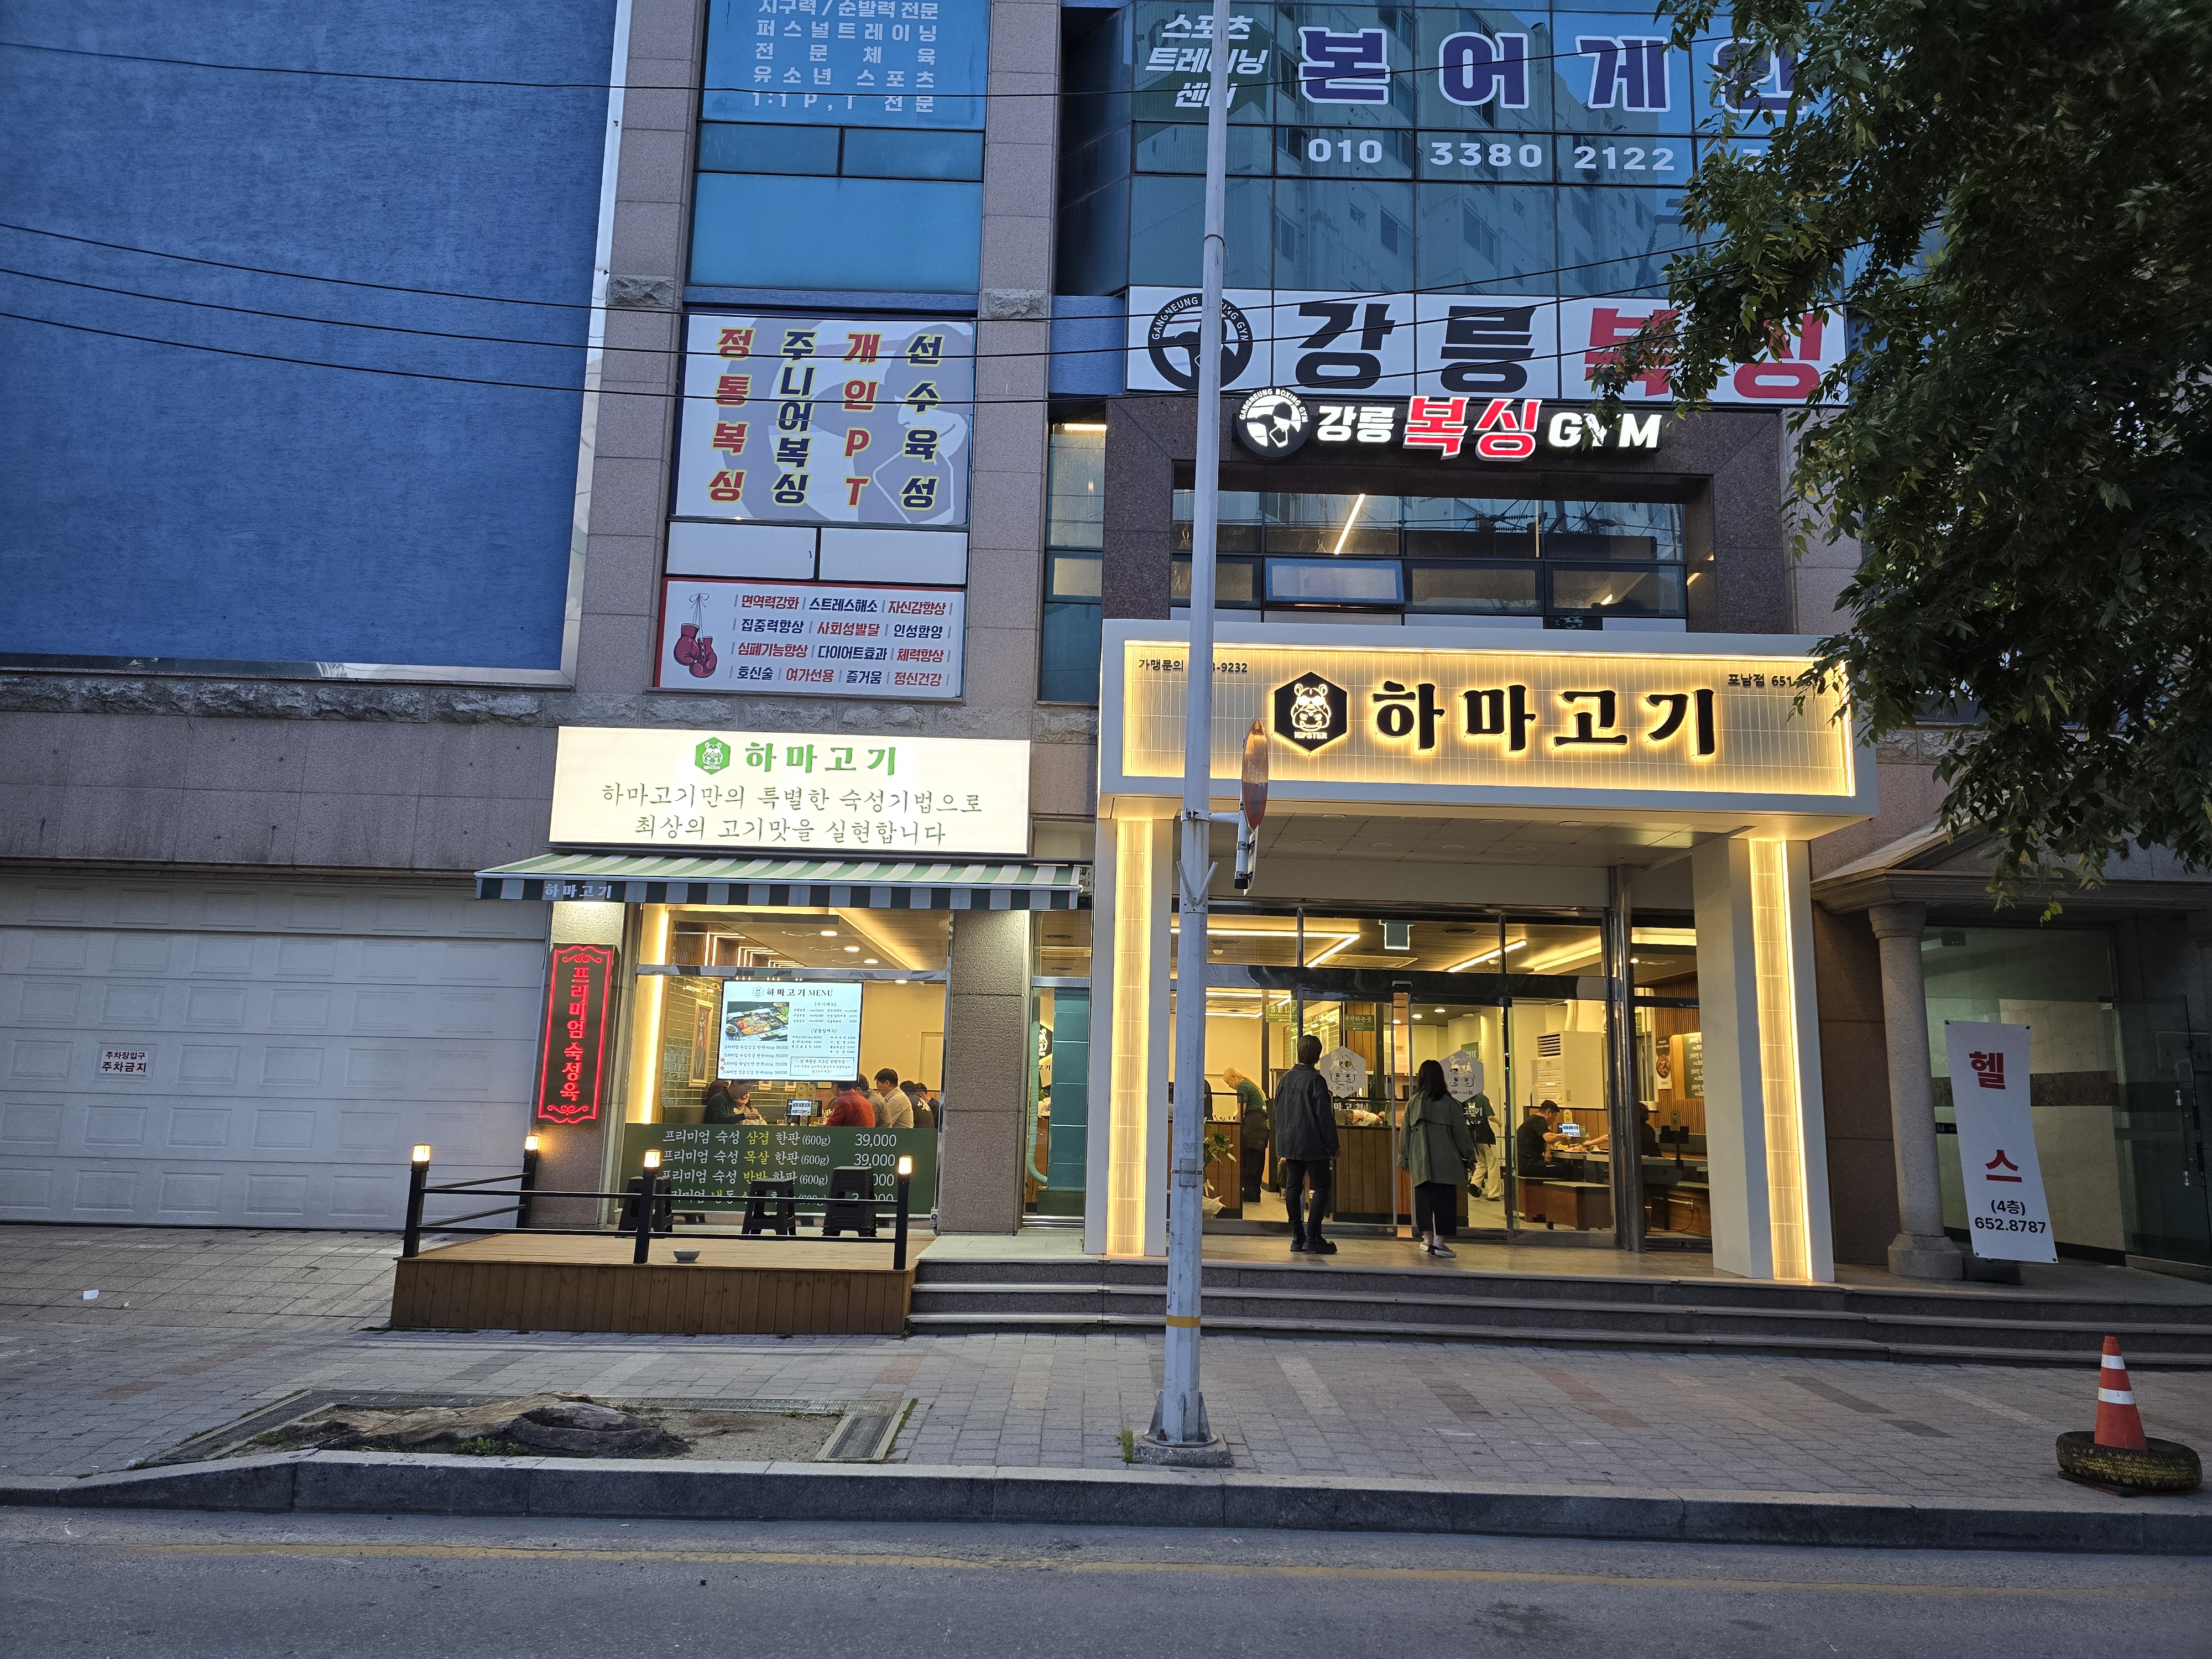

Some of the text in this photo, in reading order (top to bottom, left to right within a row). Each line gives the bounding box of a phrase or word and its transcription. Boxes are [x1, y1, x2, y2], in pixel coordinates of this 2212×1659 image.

[901, 2, 938, 20] 전문
[1161, 14, 1253, 40] 스포츠
[753, 66, 935, 89] 유소년 스포츠
[884, 95, 935, 113] 전문
[1308, 139, 1675, 171] 010 3380 2122
[1151, 296, 1199, 340] GANGNEUNG
[1237, 321, 1250, 342] GYM
[708, 327, 755, 503] 정통복싱
[1239, 388, 1310, 423] GANGNEUNG BOXING GYM
[899, 333, 945, 511] 선수육성
[1548, 411, 1663, 449] GYM
[740, 594, 947, 615] 면역력강화 스트레스해소 자신감향상
[741, 618, 943, 639] 집중력향상 사회성발달 인성함양
[737, 642, 945, 664] 심폐기능향상 다이어트효과 체력향상
[737, 665, 943, 687] 호신술 여가선용 즐거움 정신건강
[1138, 659, 1184, 672] 가맹문의
[1728, 673, 1765, 687] 포남점
[1371, 680, 1715, 756] 하마고기
[1293, 731, 1328, 740] HIPSTER
[745, 742, 897, 776] 하마고기
[601, 782, 983, 816] 하마고기만의 특별한 숙성기법으로
[634, 815, 946, 847] 최상의 고기맛을 실현합니다
[545, 884, 612, 899] 하마고기
[766, 988, 806, 997] 하마고기
[106, 1051, 145, 1060] 주차장입구
[102, 1062, 147, 1073] 주차금지
[1333, 1102, 1364, 1112] 마고기
[1969, 1051, 2023, 1183] 헬스
[662, 1129, 710, 1144] 프리미엄
[714, 1130, 740, 1145] 숙성
[745, 1130, 769, 1145] 삼겹
[854, 1133, 897, 1148] 39,000
[661, 1149, 708, 1164] 프리미엄
[713, 1150, 738, 1165] 숙성
[743, 1150, 770, 1165] 목살
[853, 1153, 895, 1167] 39,000
[662, 1168, 707, 1184] 프리미엄
[712, 1170, 737, 1185] 숙성
[1991, 1199, 2026, 1216] (4층)
[1975, 1217, 2046, 1234] 652.8787
